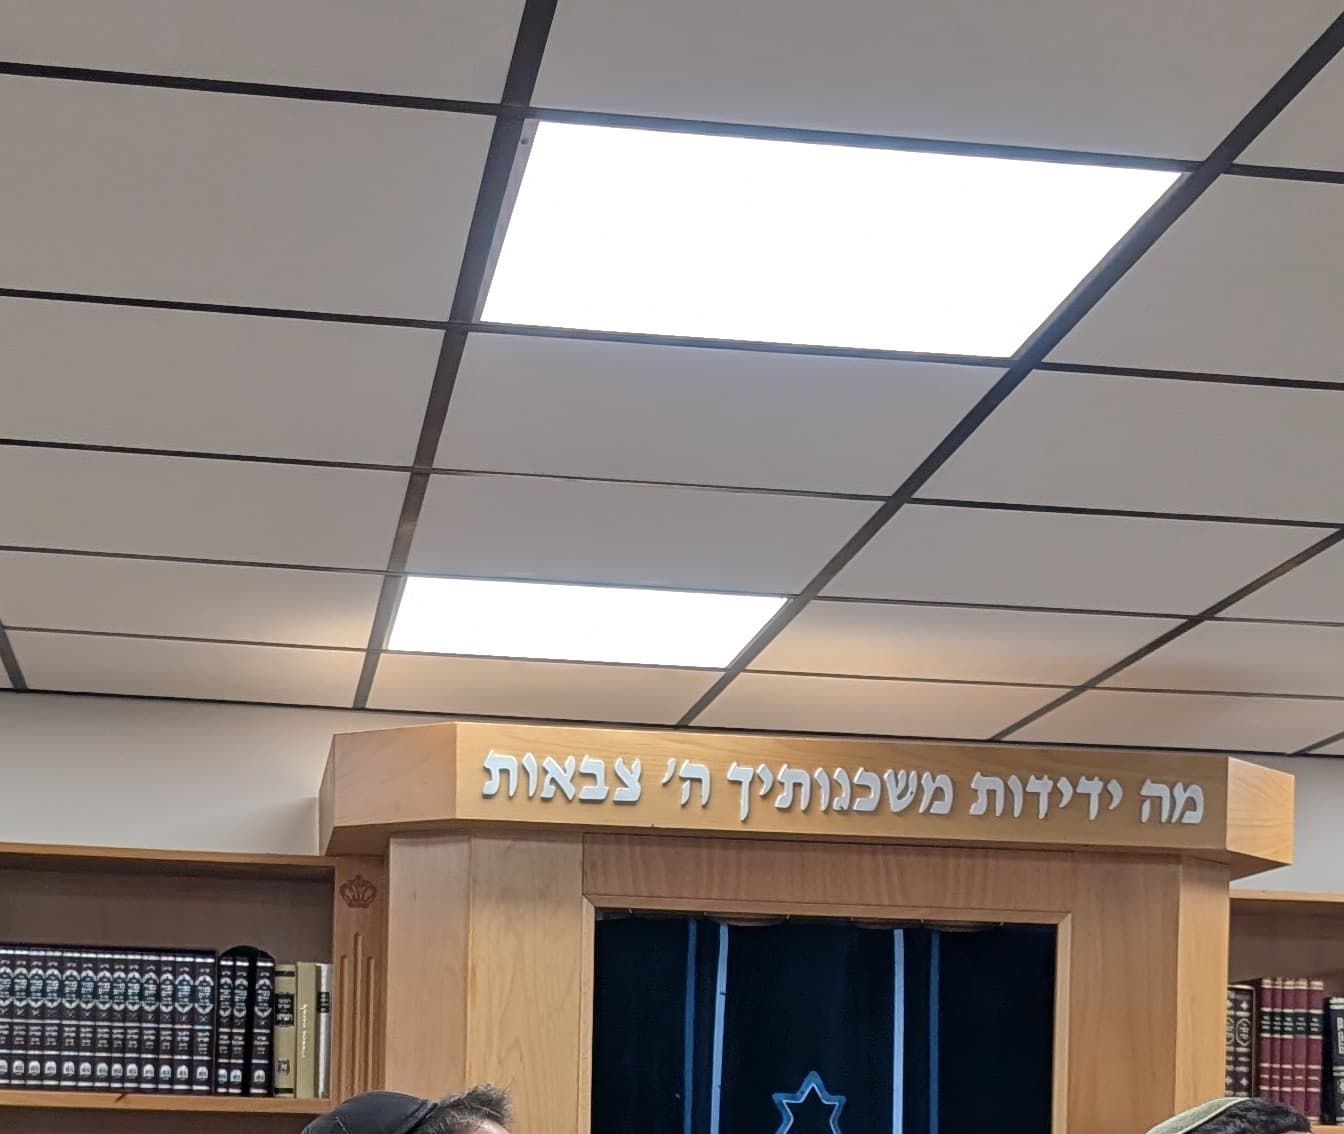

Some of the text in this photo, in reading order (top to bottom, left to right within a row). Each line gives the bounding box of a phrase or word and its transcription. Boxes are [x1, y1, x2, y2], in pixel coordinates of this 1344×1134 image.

[482, 749, 643, 802] צבאות
[728, 762, 951, 821] משכנותיך
[969, 772, 1123, 821] ידידות
[1140, 780, 1205, 824] מה
